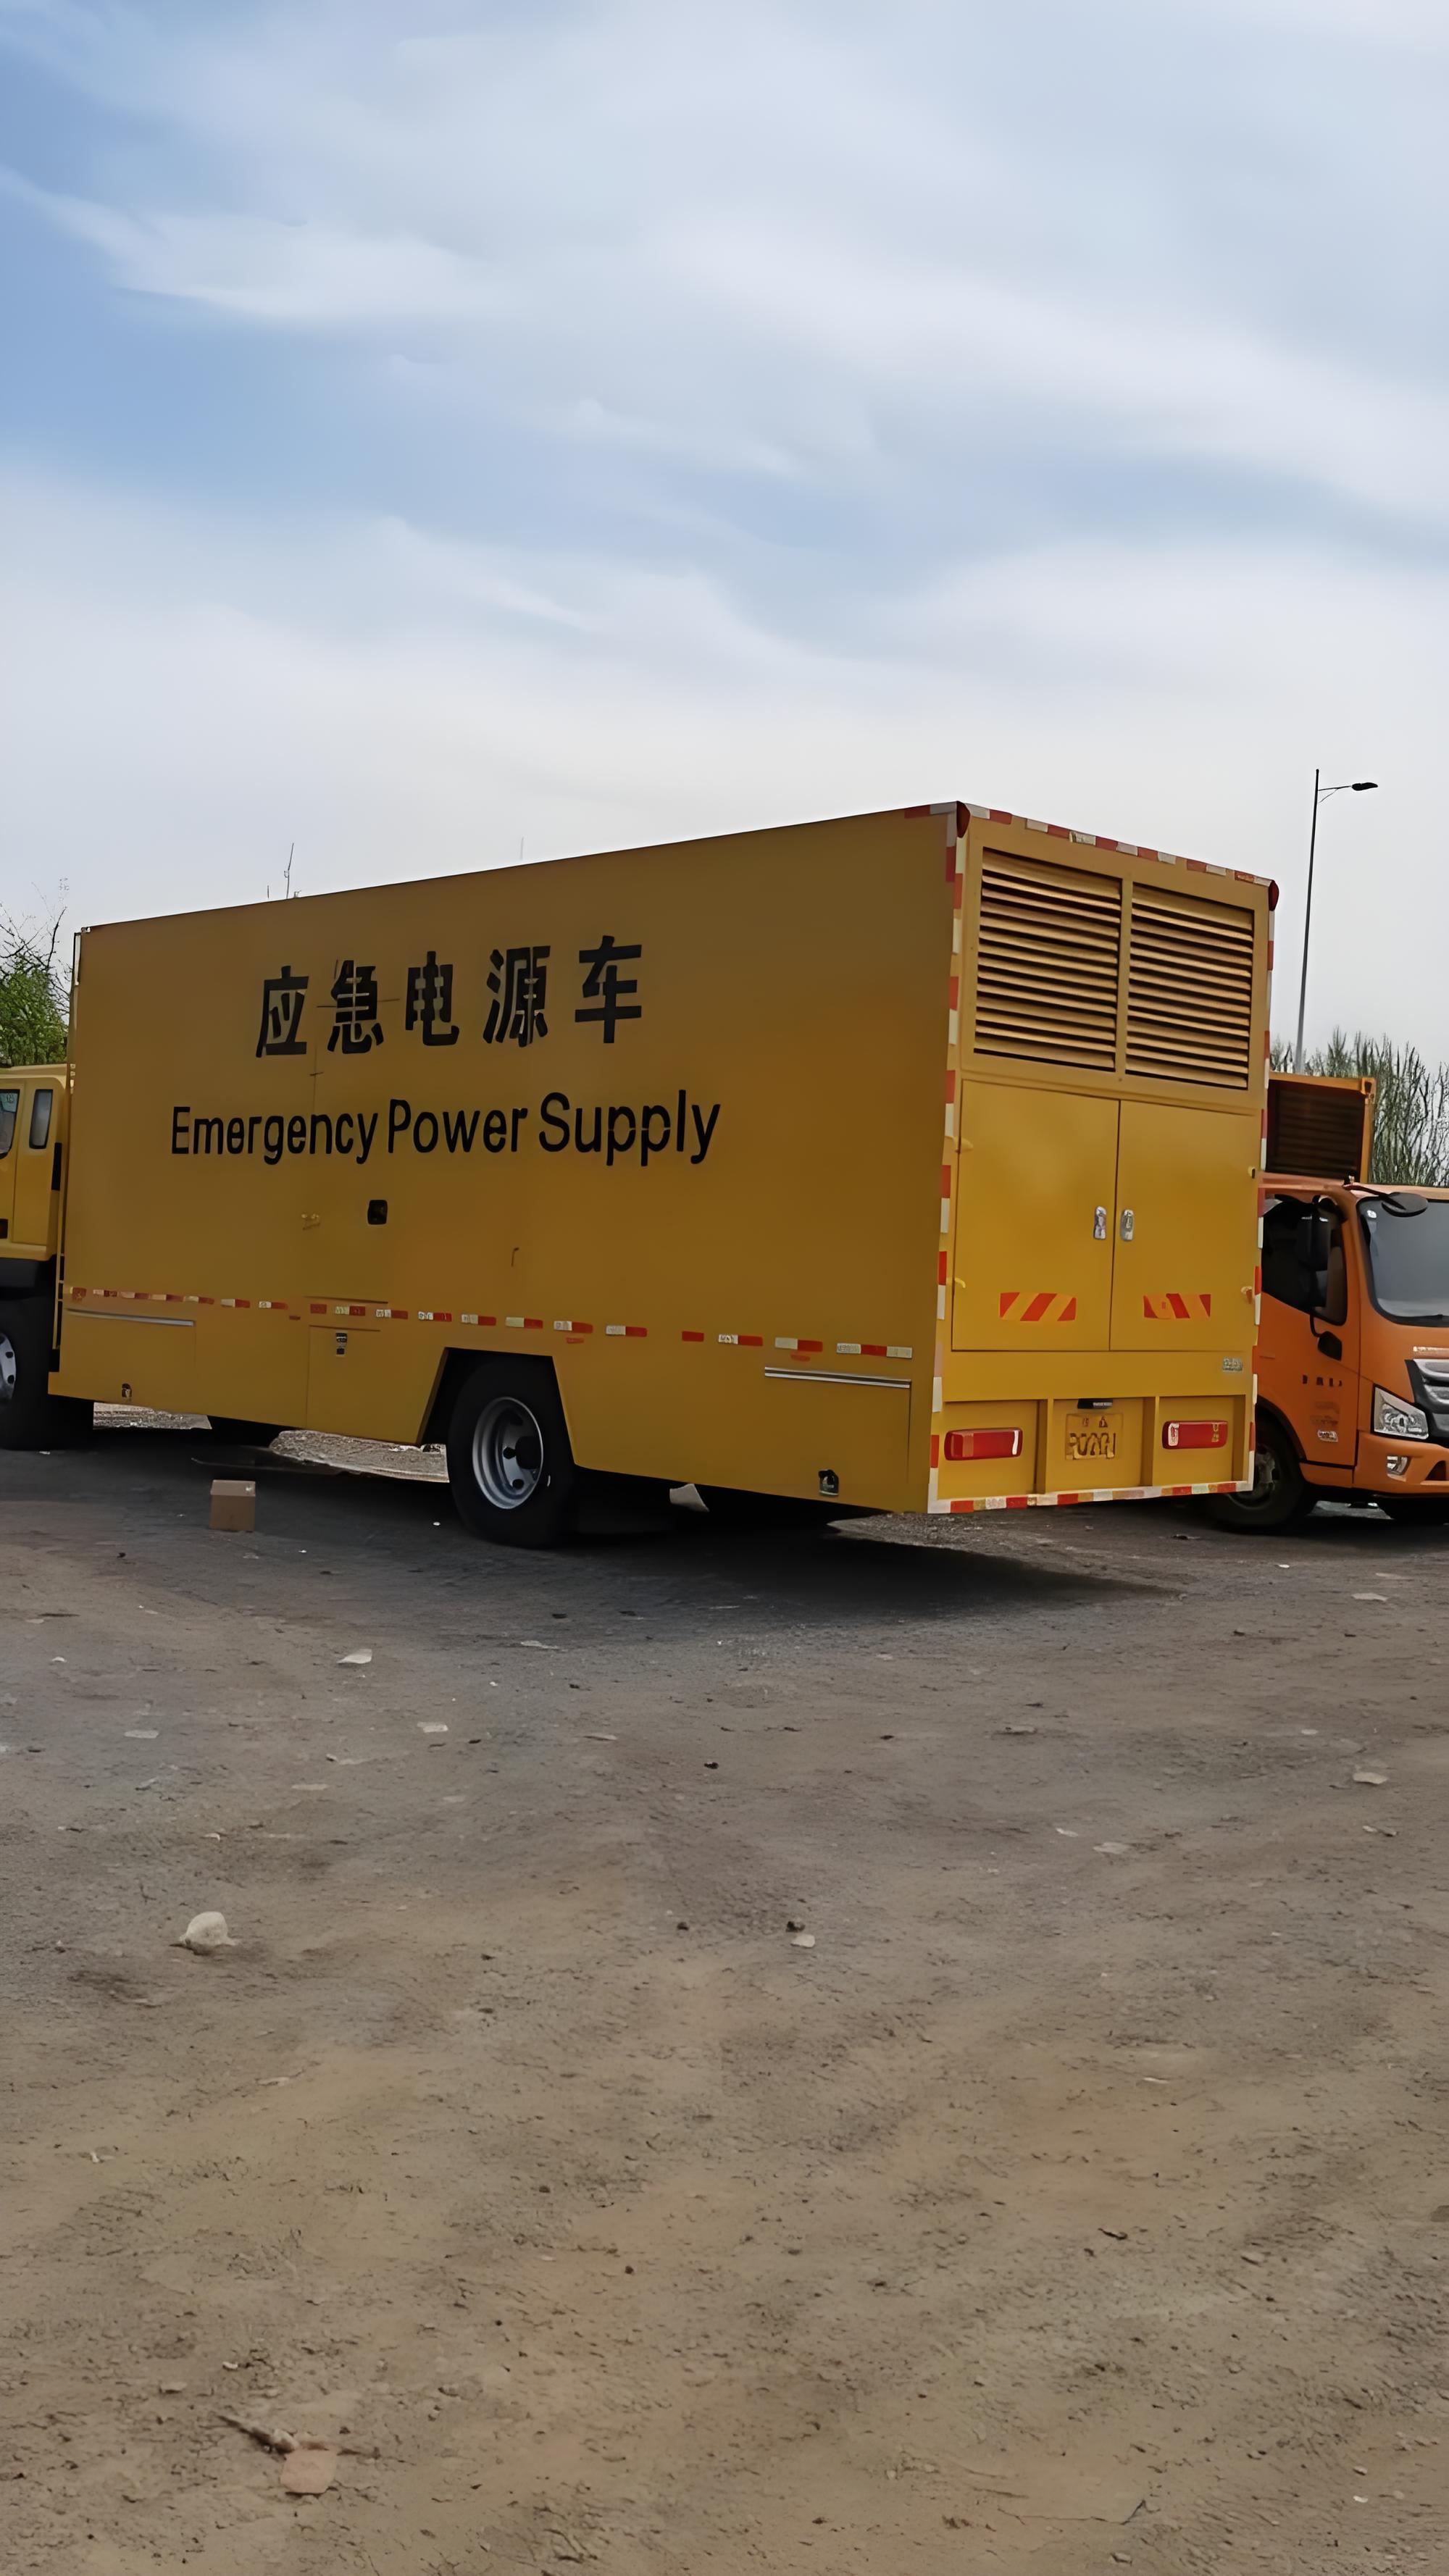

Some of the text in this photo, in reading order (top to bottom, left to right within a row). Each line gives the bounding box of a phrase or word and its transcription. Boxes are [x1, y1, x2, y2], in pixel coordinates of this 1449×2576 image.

[255, 934, 643, 1058] 应急电源车
[171, 1089, 721, 1167] Emergency Power Supply
